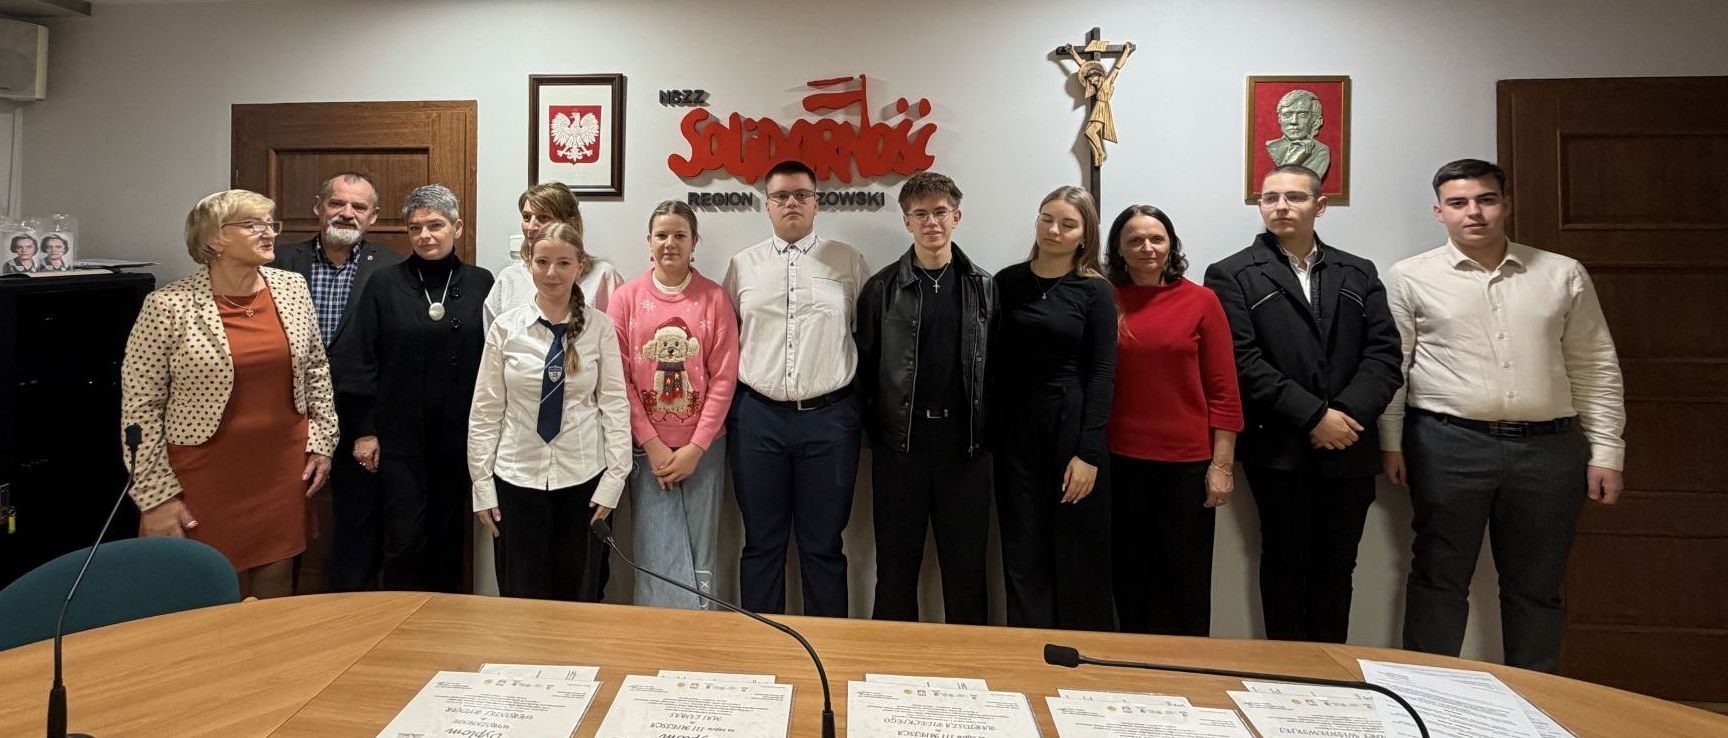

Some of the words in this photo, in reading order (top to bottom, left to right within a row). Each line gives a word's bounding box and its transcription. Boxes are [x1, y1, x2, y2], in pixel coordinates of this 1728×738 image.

[659, 89, 705, 104] NSZZ
[687, 192, 753, 206] REGION
[816, 192, 885, 206] ZOWSKI
